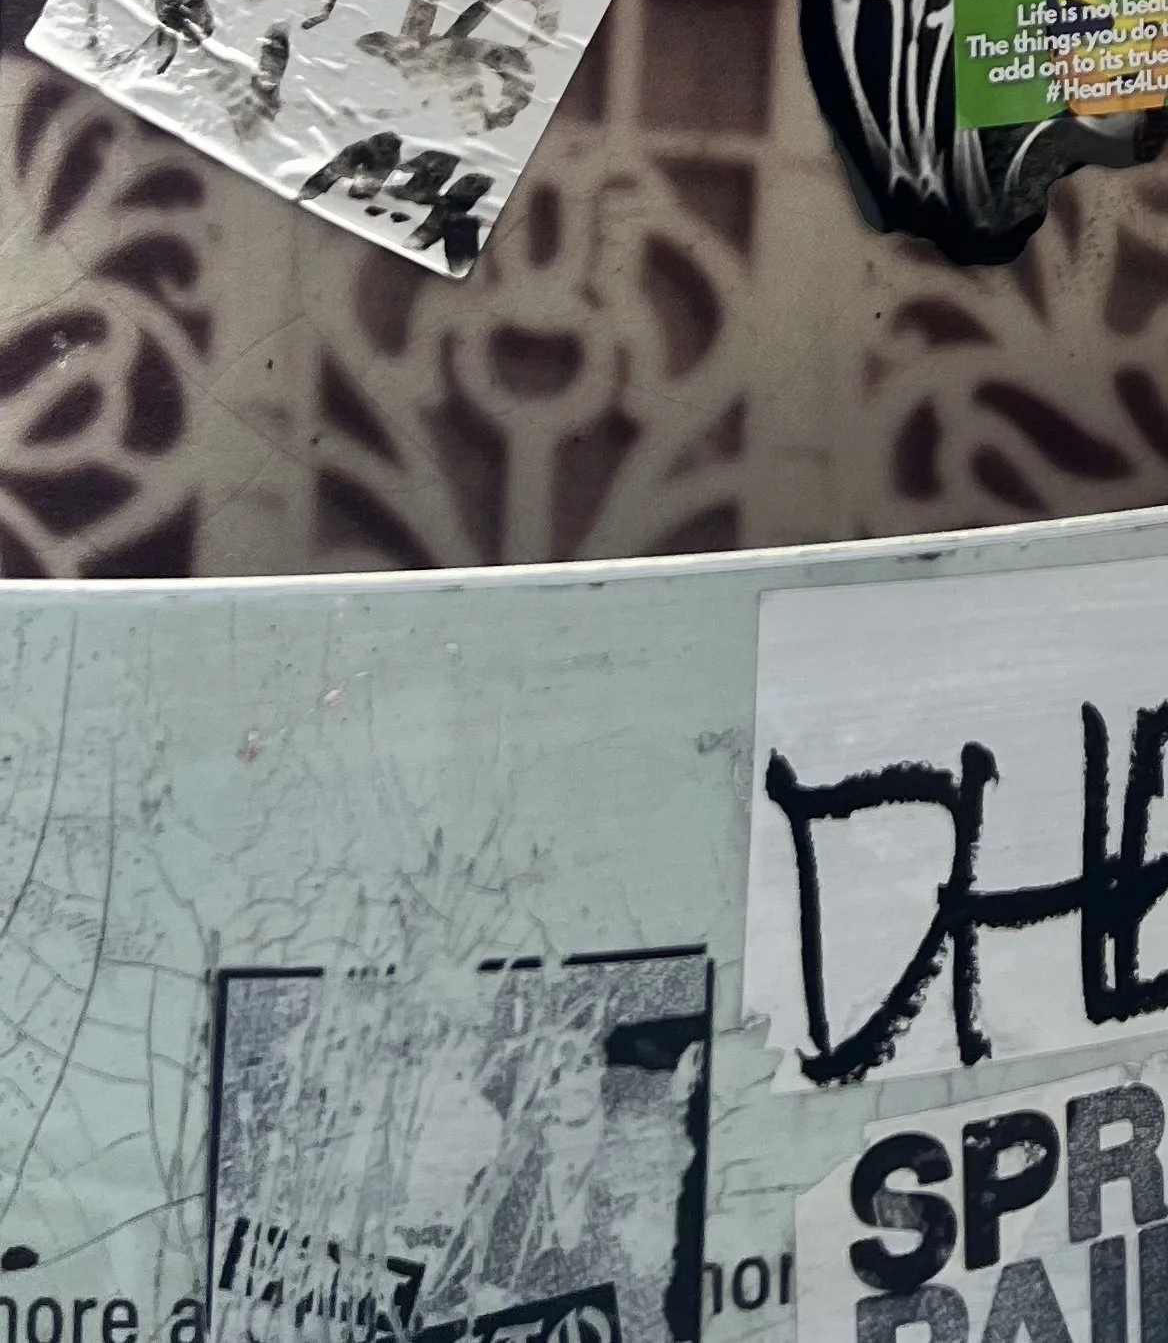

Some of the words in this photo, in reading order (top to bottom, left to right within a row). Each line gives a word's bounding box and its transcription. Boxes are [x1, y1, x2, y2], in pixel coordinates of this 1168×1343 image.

[1017, 3, 1058, 28] Life
[966, 33, 1010, 59] The
[1014, 28, 1081, 55] things
[1085, 26, 1126, 49] you
[1130, 20, 1158, 41] do
[988, 56, 1036, 83] add
[1039, 59, 1069, 78] on
[1073, 53, 1096, 74] to
[1100, 49, 1125, 72] its
